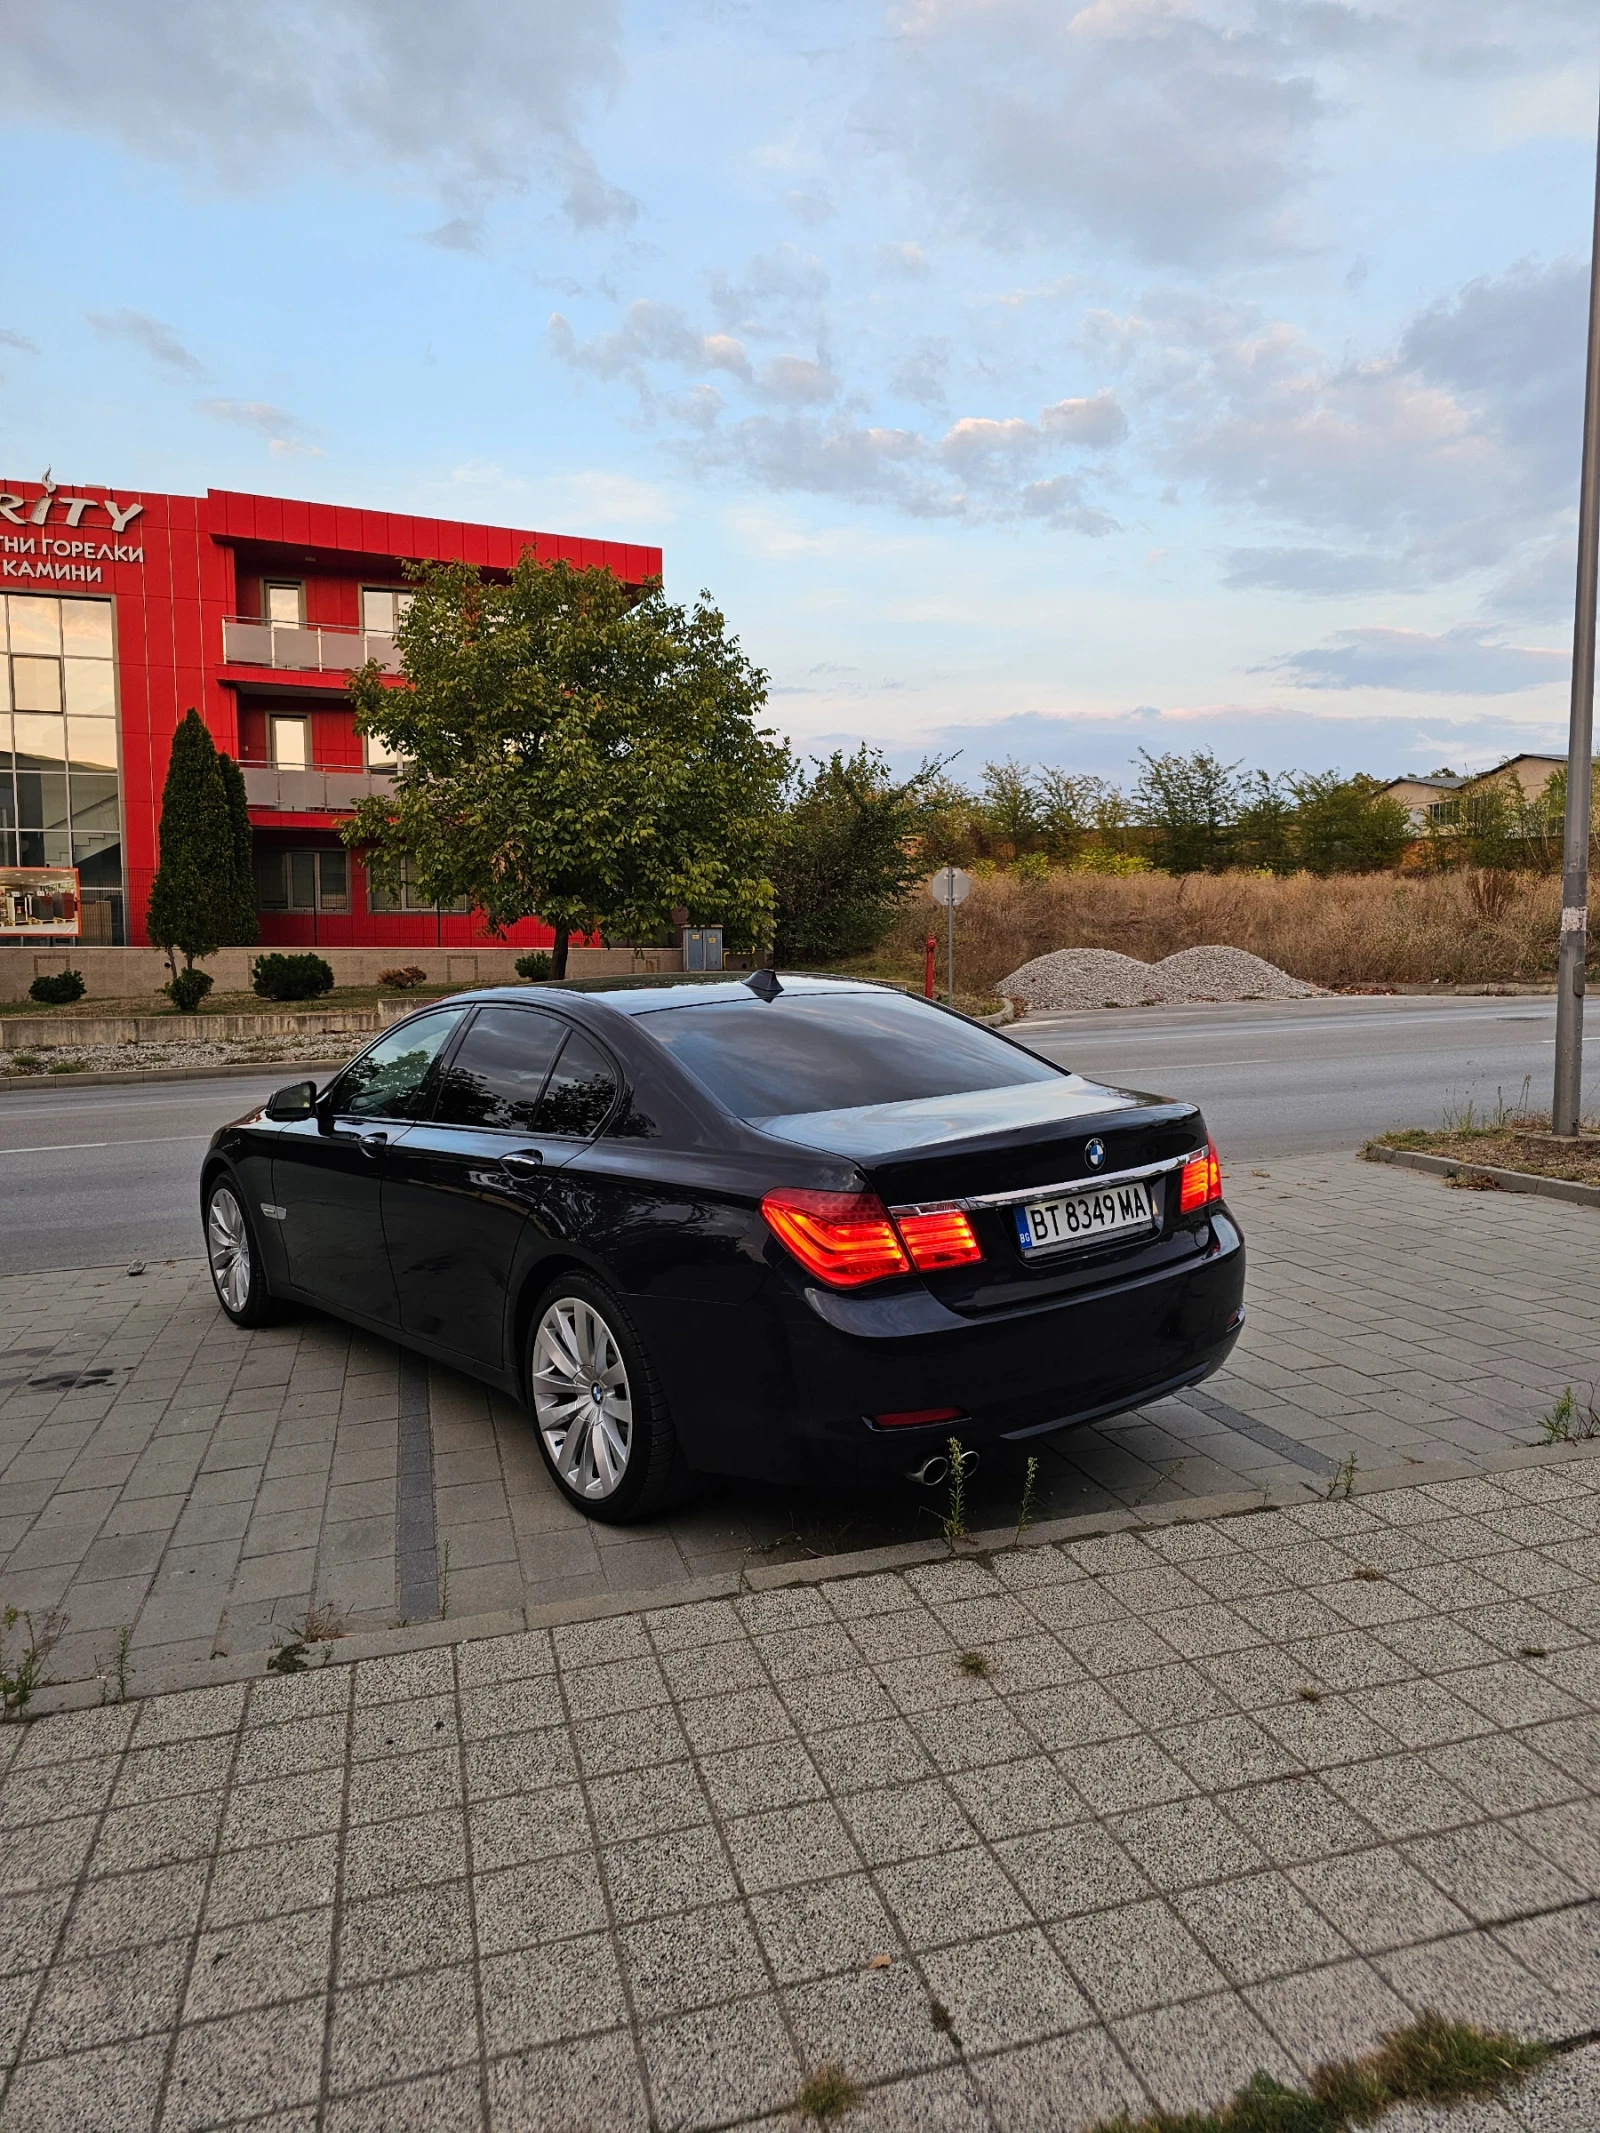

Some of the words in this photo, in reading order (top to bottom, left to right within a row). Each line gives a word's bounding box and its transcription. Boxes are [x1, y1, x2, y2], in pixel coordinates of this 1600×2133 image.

[42, 538, 144, 563] ГОРЕЛКИ
[3, 559, 102, 583] КАМИНИ
[1030, 1205, 1059, 1240] BT
[1065, 1194, 1115, 1232] 8349
[1117, 1188, 1147, 1220] MA
[1020, 1232, 1031, 1243] BG
